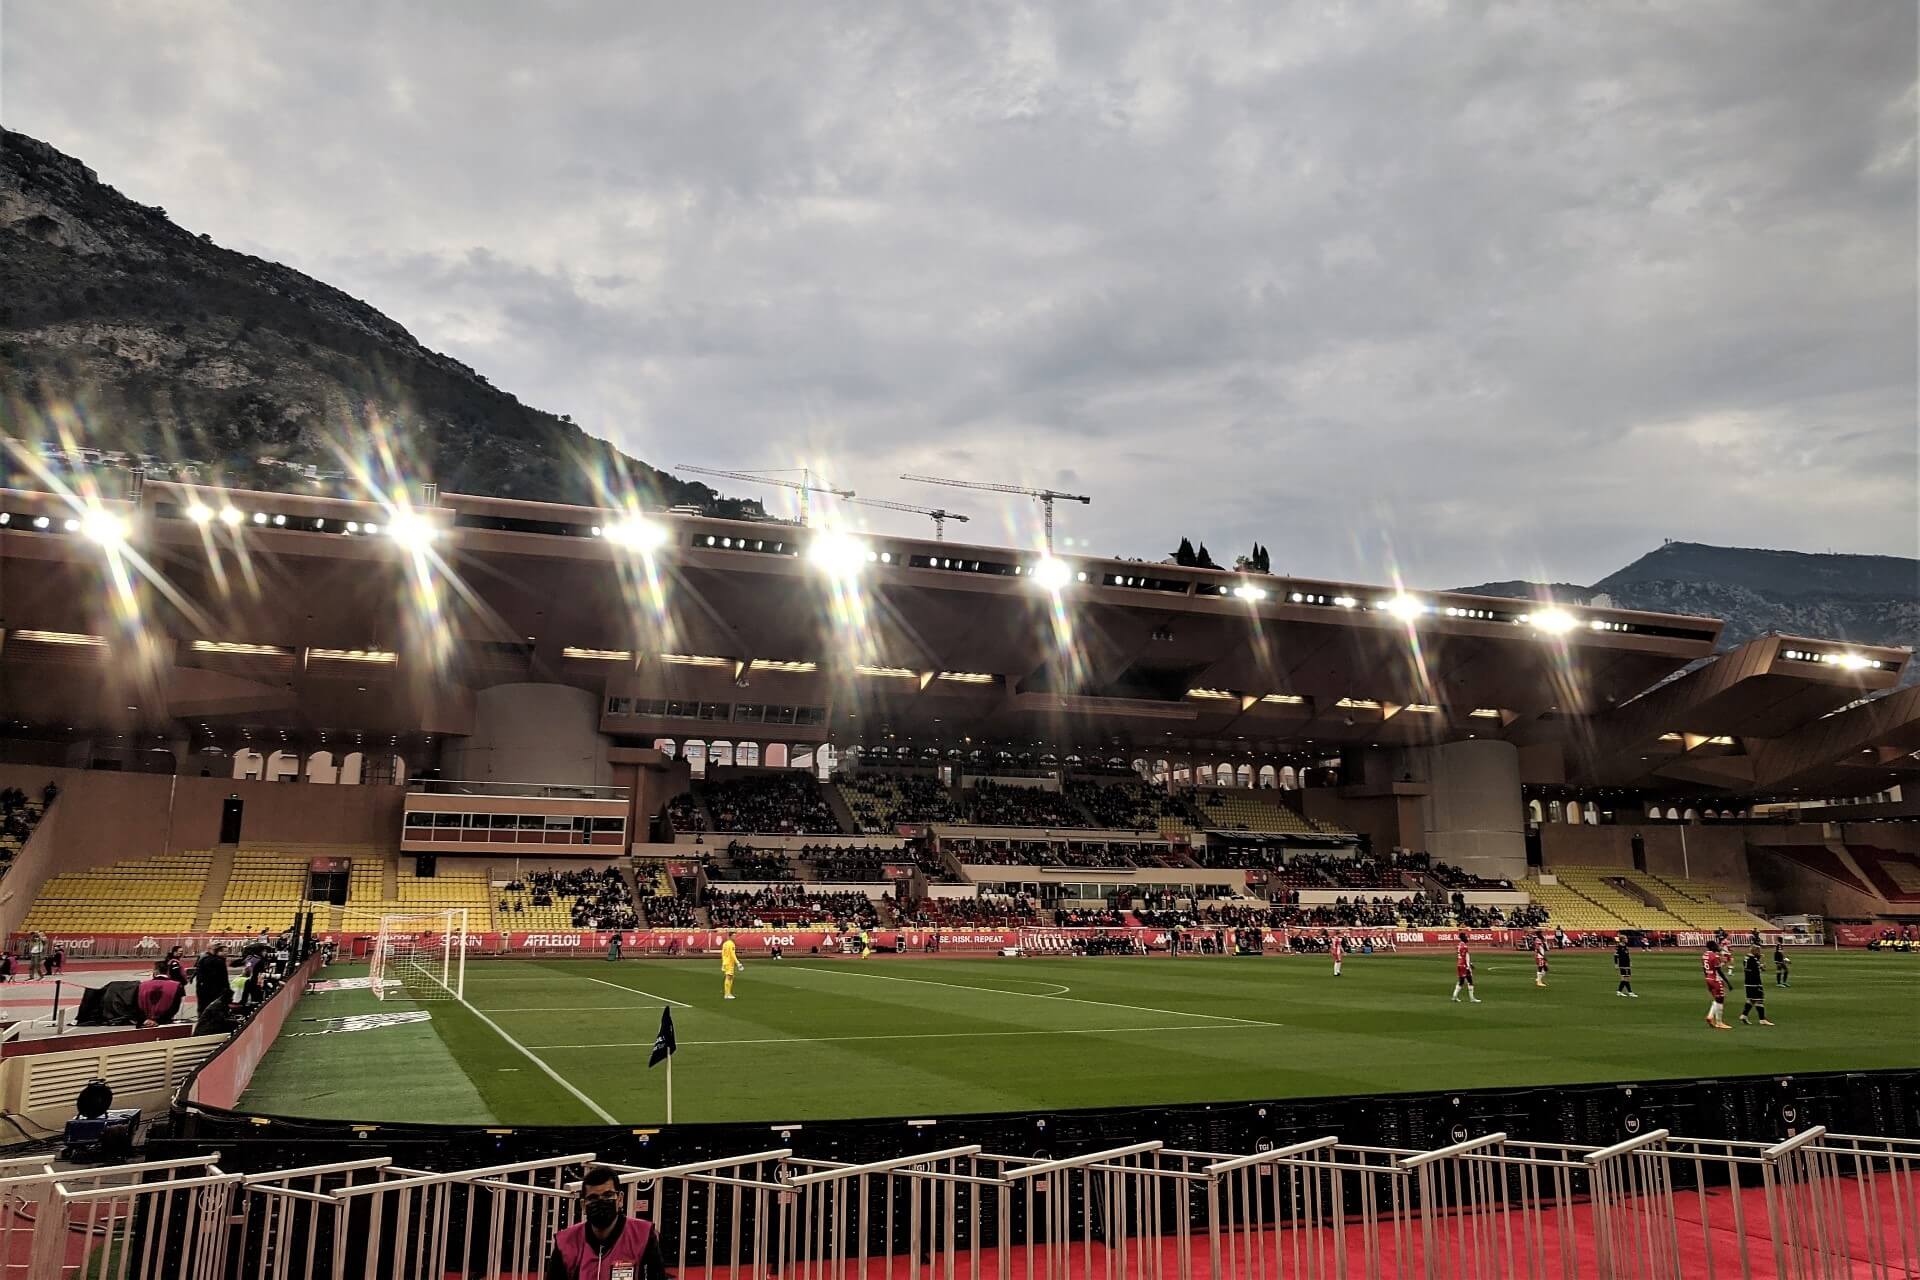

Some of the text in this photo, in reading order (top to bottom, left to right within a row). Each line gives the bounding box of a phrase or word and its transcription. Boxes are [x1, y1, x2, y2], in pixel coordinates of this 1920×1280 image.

[523, 934, 581, 947] AFFLELOU
[763, 934, 795, 946] vbet
[974, 935, 1004, 943] REPEAT.
[1396, 932, 1425, 943] FEDCOM
[1258, 1143, 1270, 1151] TGI
